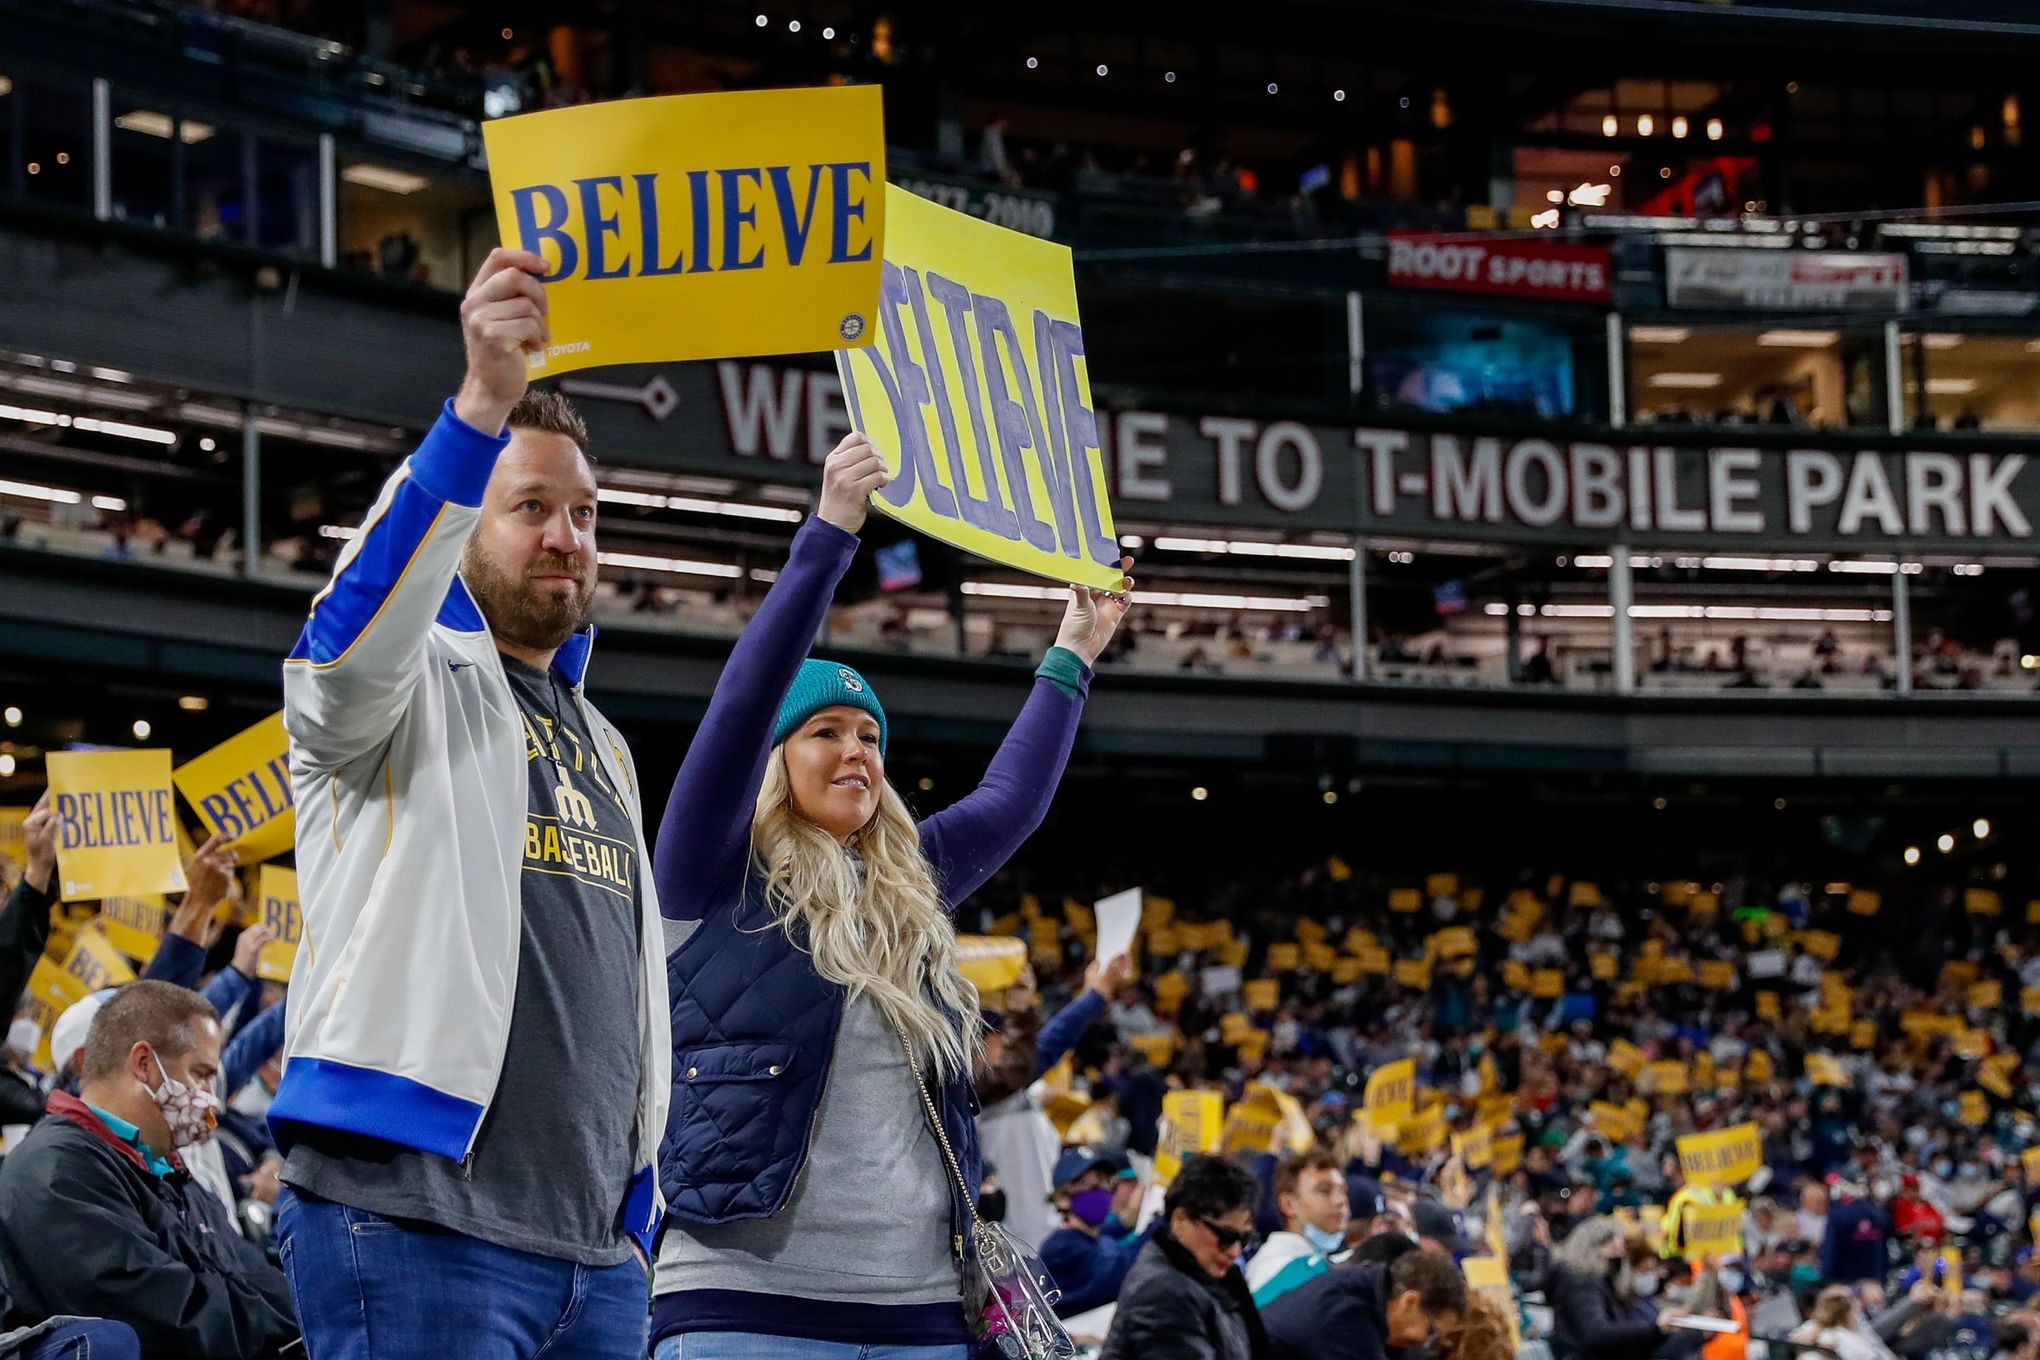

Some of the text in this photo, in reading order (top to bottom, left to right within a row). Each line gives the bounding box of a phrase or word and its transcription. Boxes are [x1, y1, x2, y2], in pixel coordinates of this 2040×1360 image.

[510, 162, 873, 283] BELIEVE
[1389, 240, 1604, 292] ROOT SPORTS
[547, 341, 592, 357] TOYOTA
[1201, 416, 1323, 512] TO
[1355, 429, 1765, 532] T-MOBILE
[1787, 450, 2033, 538] PARK
[57, 789, 174, 850] BELIEVE
[200, 754, 294, 841] BELI
